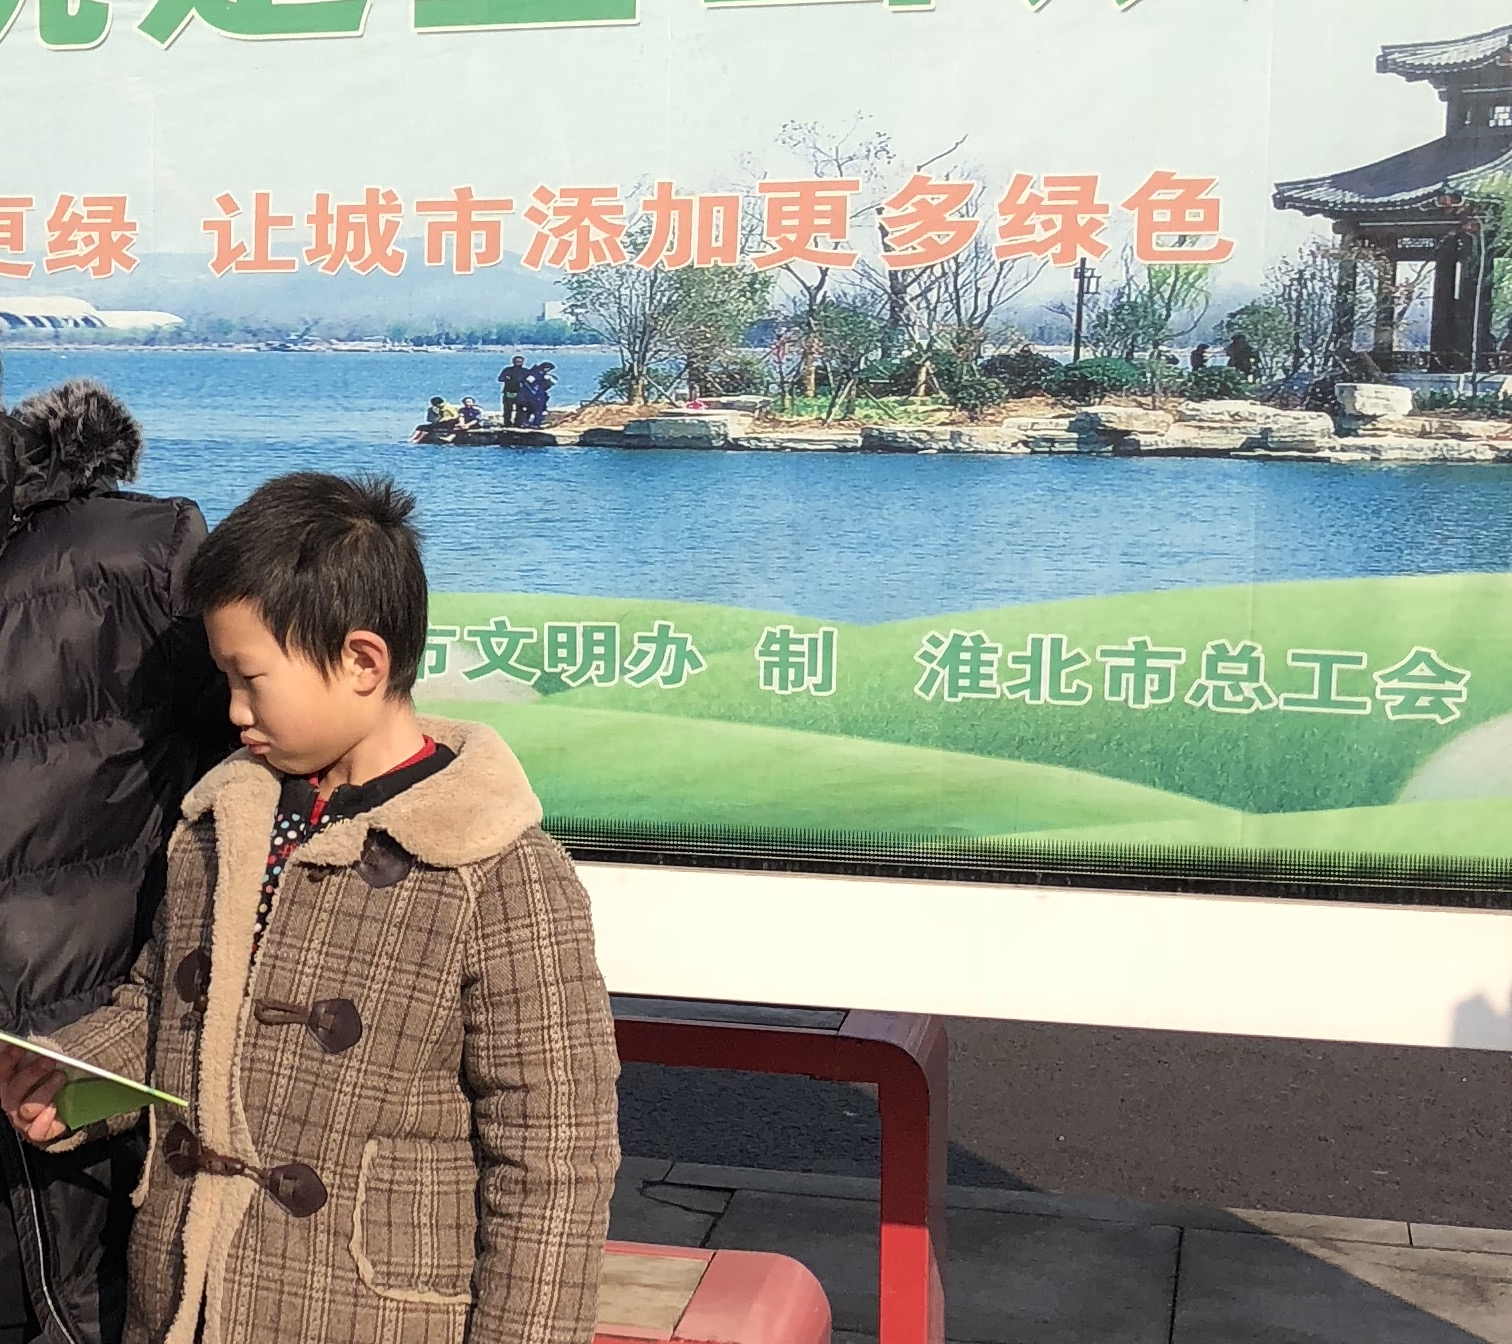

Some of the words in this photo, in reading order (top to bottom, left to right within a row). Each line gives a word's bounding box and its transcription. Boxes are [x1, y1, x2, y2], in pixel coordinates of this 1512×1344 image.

[201, 168, 1239, 278] 让城市添加更多绿色
[754, 625, 838, 697] 制
[913, 628, 1470, 724] 淮北市总工会
